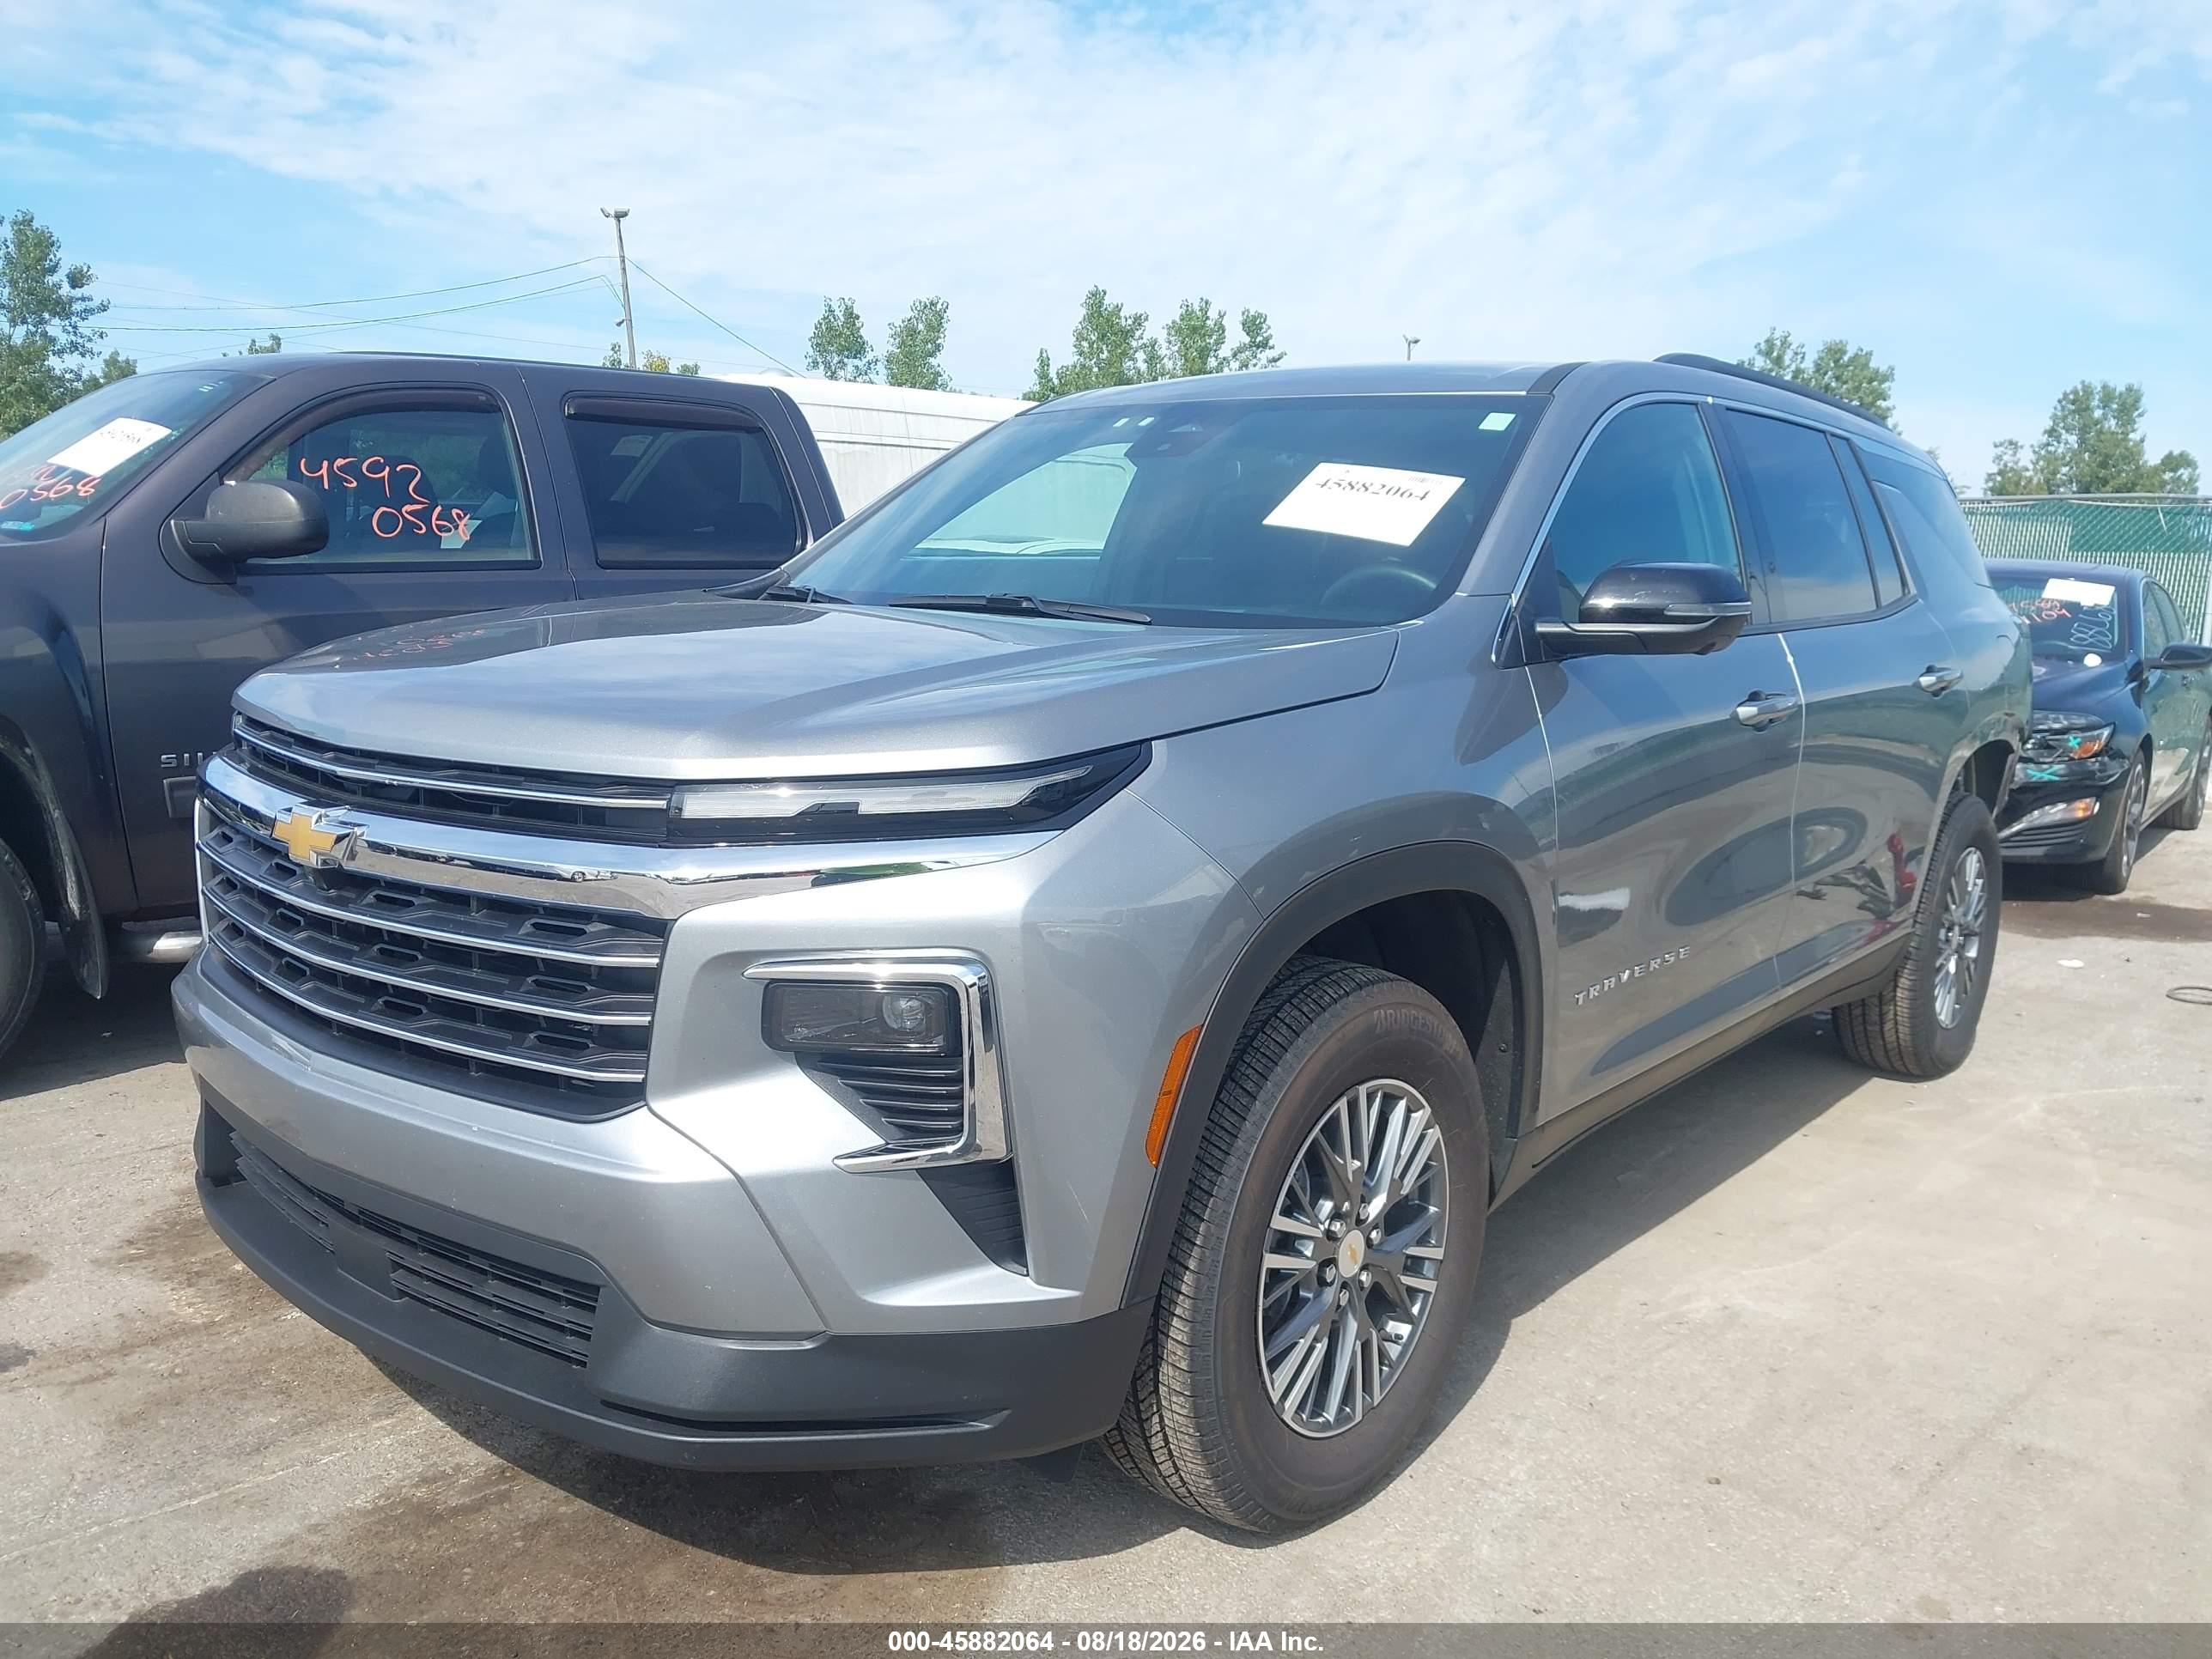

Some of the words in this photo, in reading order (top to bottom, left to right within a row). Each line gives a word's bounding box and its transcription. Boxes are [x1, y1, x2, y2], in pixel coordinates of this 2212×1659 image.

[0, 476, 102, 509] 0568
[300, 456, 431, 503] 4592
[1316, 477, 1431, 501] 45882064
[371, 503, 471, 541] 0568
[1574, 945, 1691, 1006] TRAVERSE
